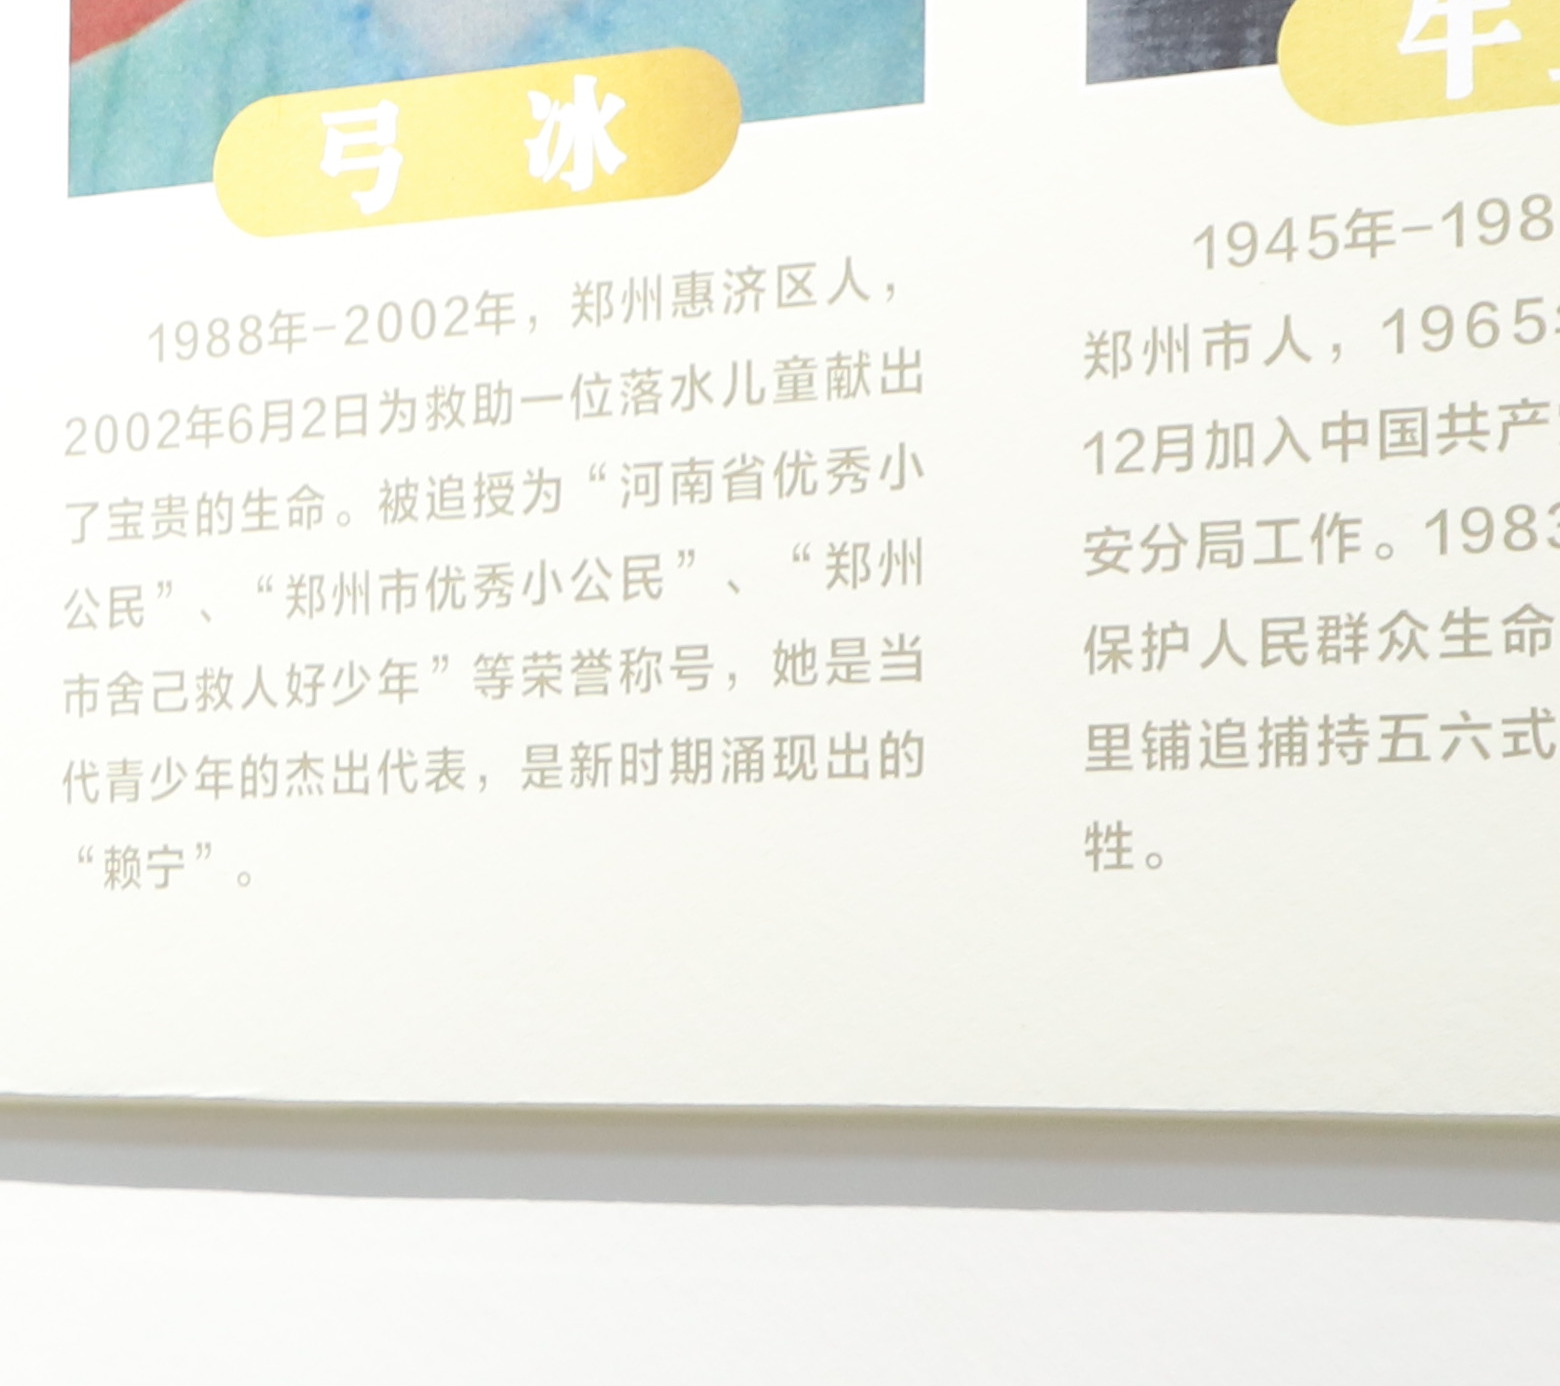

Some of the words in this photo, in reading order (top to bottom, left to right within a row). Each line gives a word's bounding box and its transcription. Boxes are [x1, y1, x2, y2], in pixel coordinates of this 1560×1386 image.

[1083, 296, 1560, 382] 郑州市人，1965
[65, 345, 924, 457] 2002年6月2日为救助一位落水儿童献出
[1082, 396, 1560, 477] 12月加入中国共产
[1082, 602, 1557, 677] 保护人民群众生命
[61, 728, 925, 806] 代青少年的杰出代表，是新时期涌现出的
[1084, 705, 1558, 774] 里铺追捕持五六式
